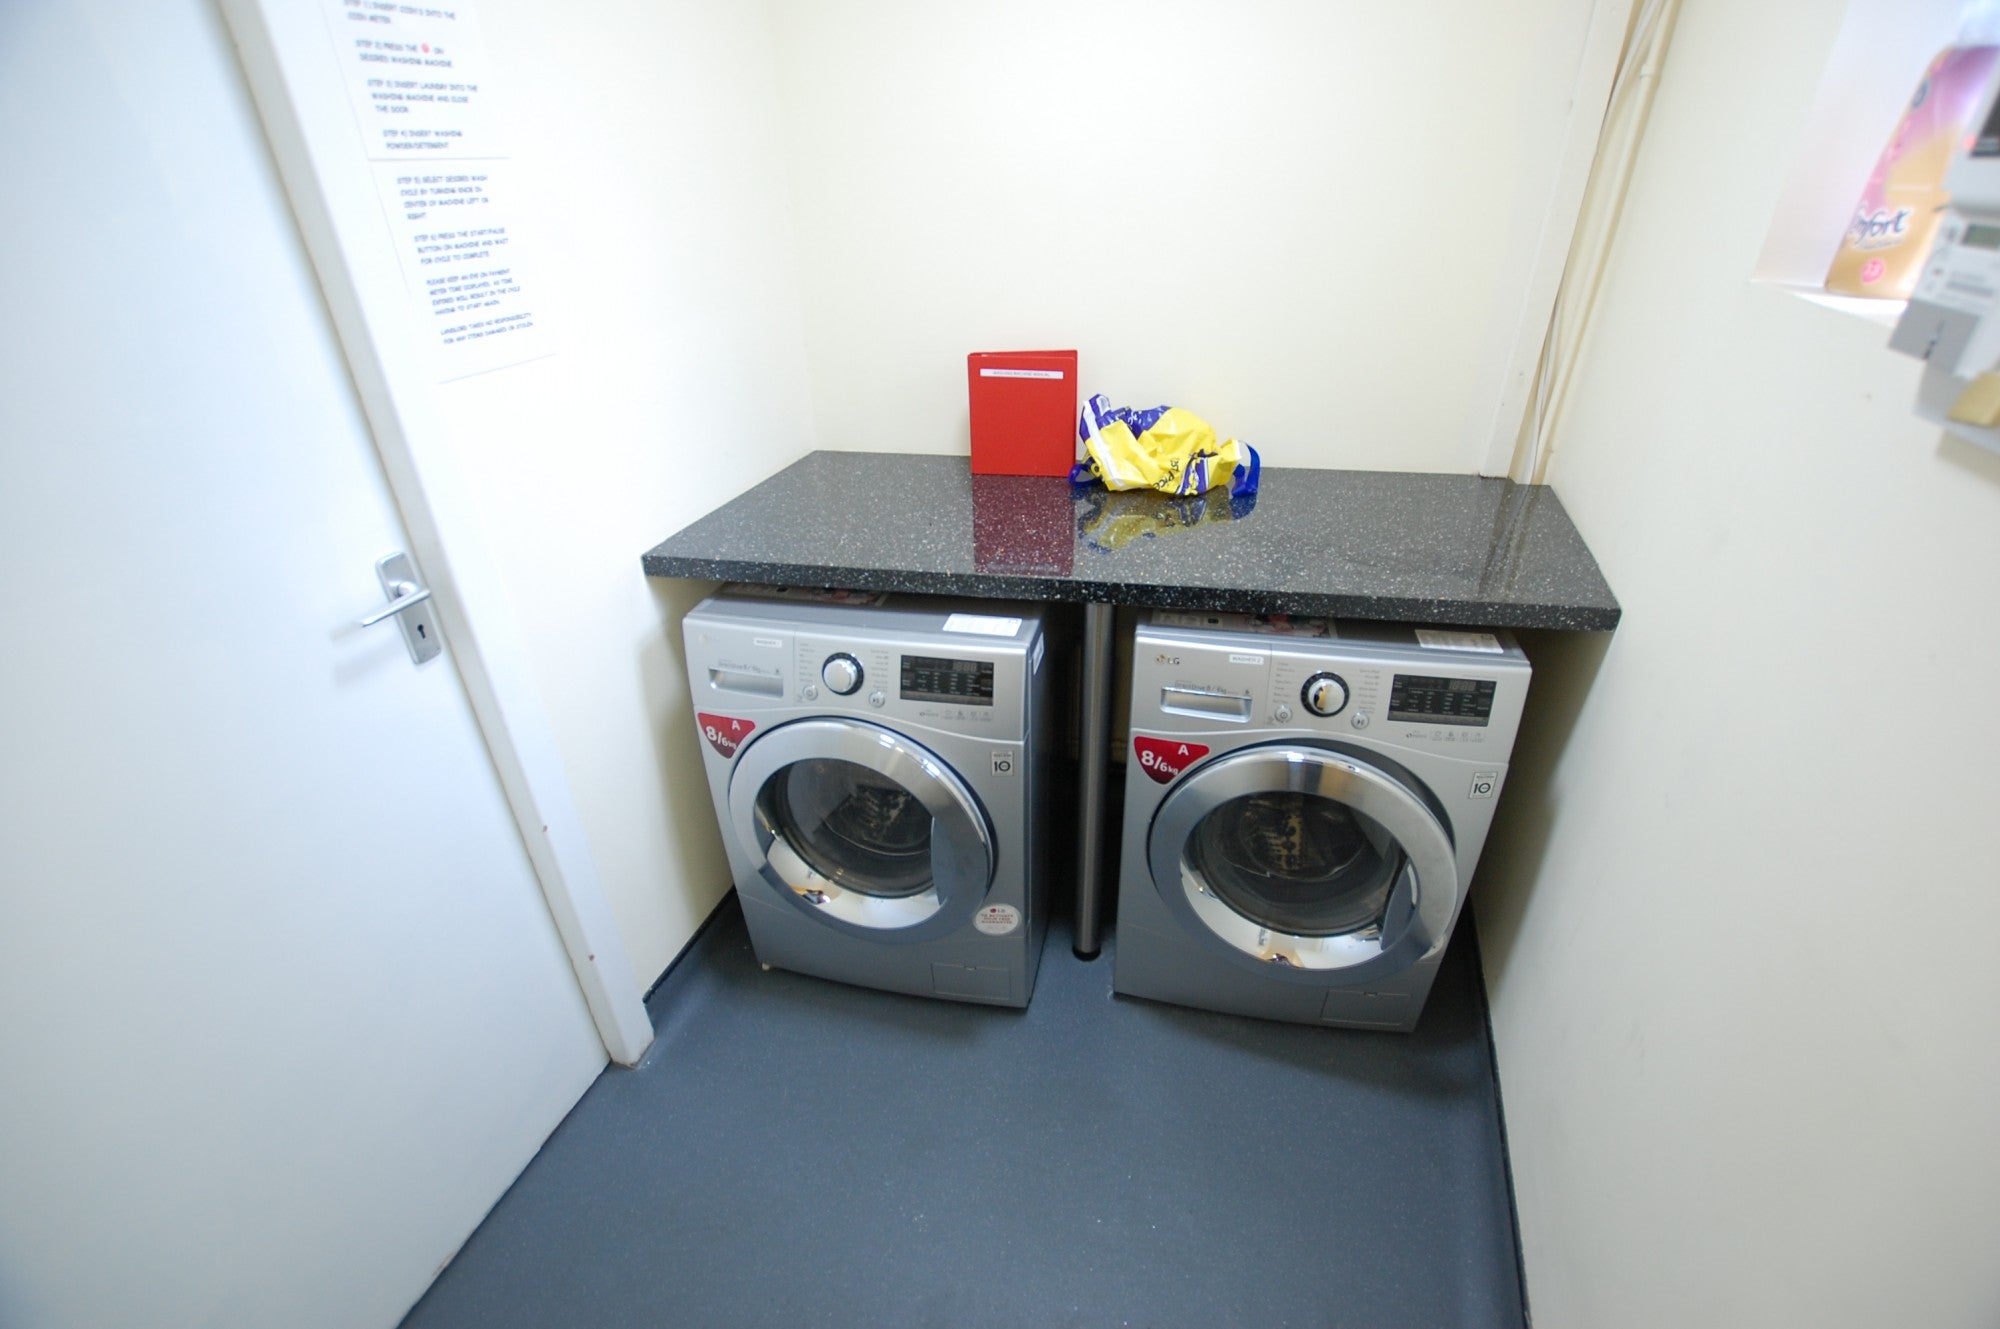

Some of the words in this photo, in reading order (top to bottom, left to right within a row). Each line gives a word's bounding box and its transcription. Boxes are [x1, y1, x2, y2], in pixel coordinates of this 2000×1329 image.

[1167, 657, 1181, 665] LG
[732, 720, 741, 731] A
[1178, 744, 1189, 756] A
